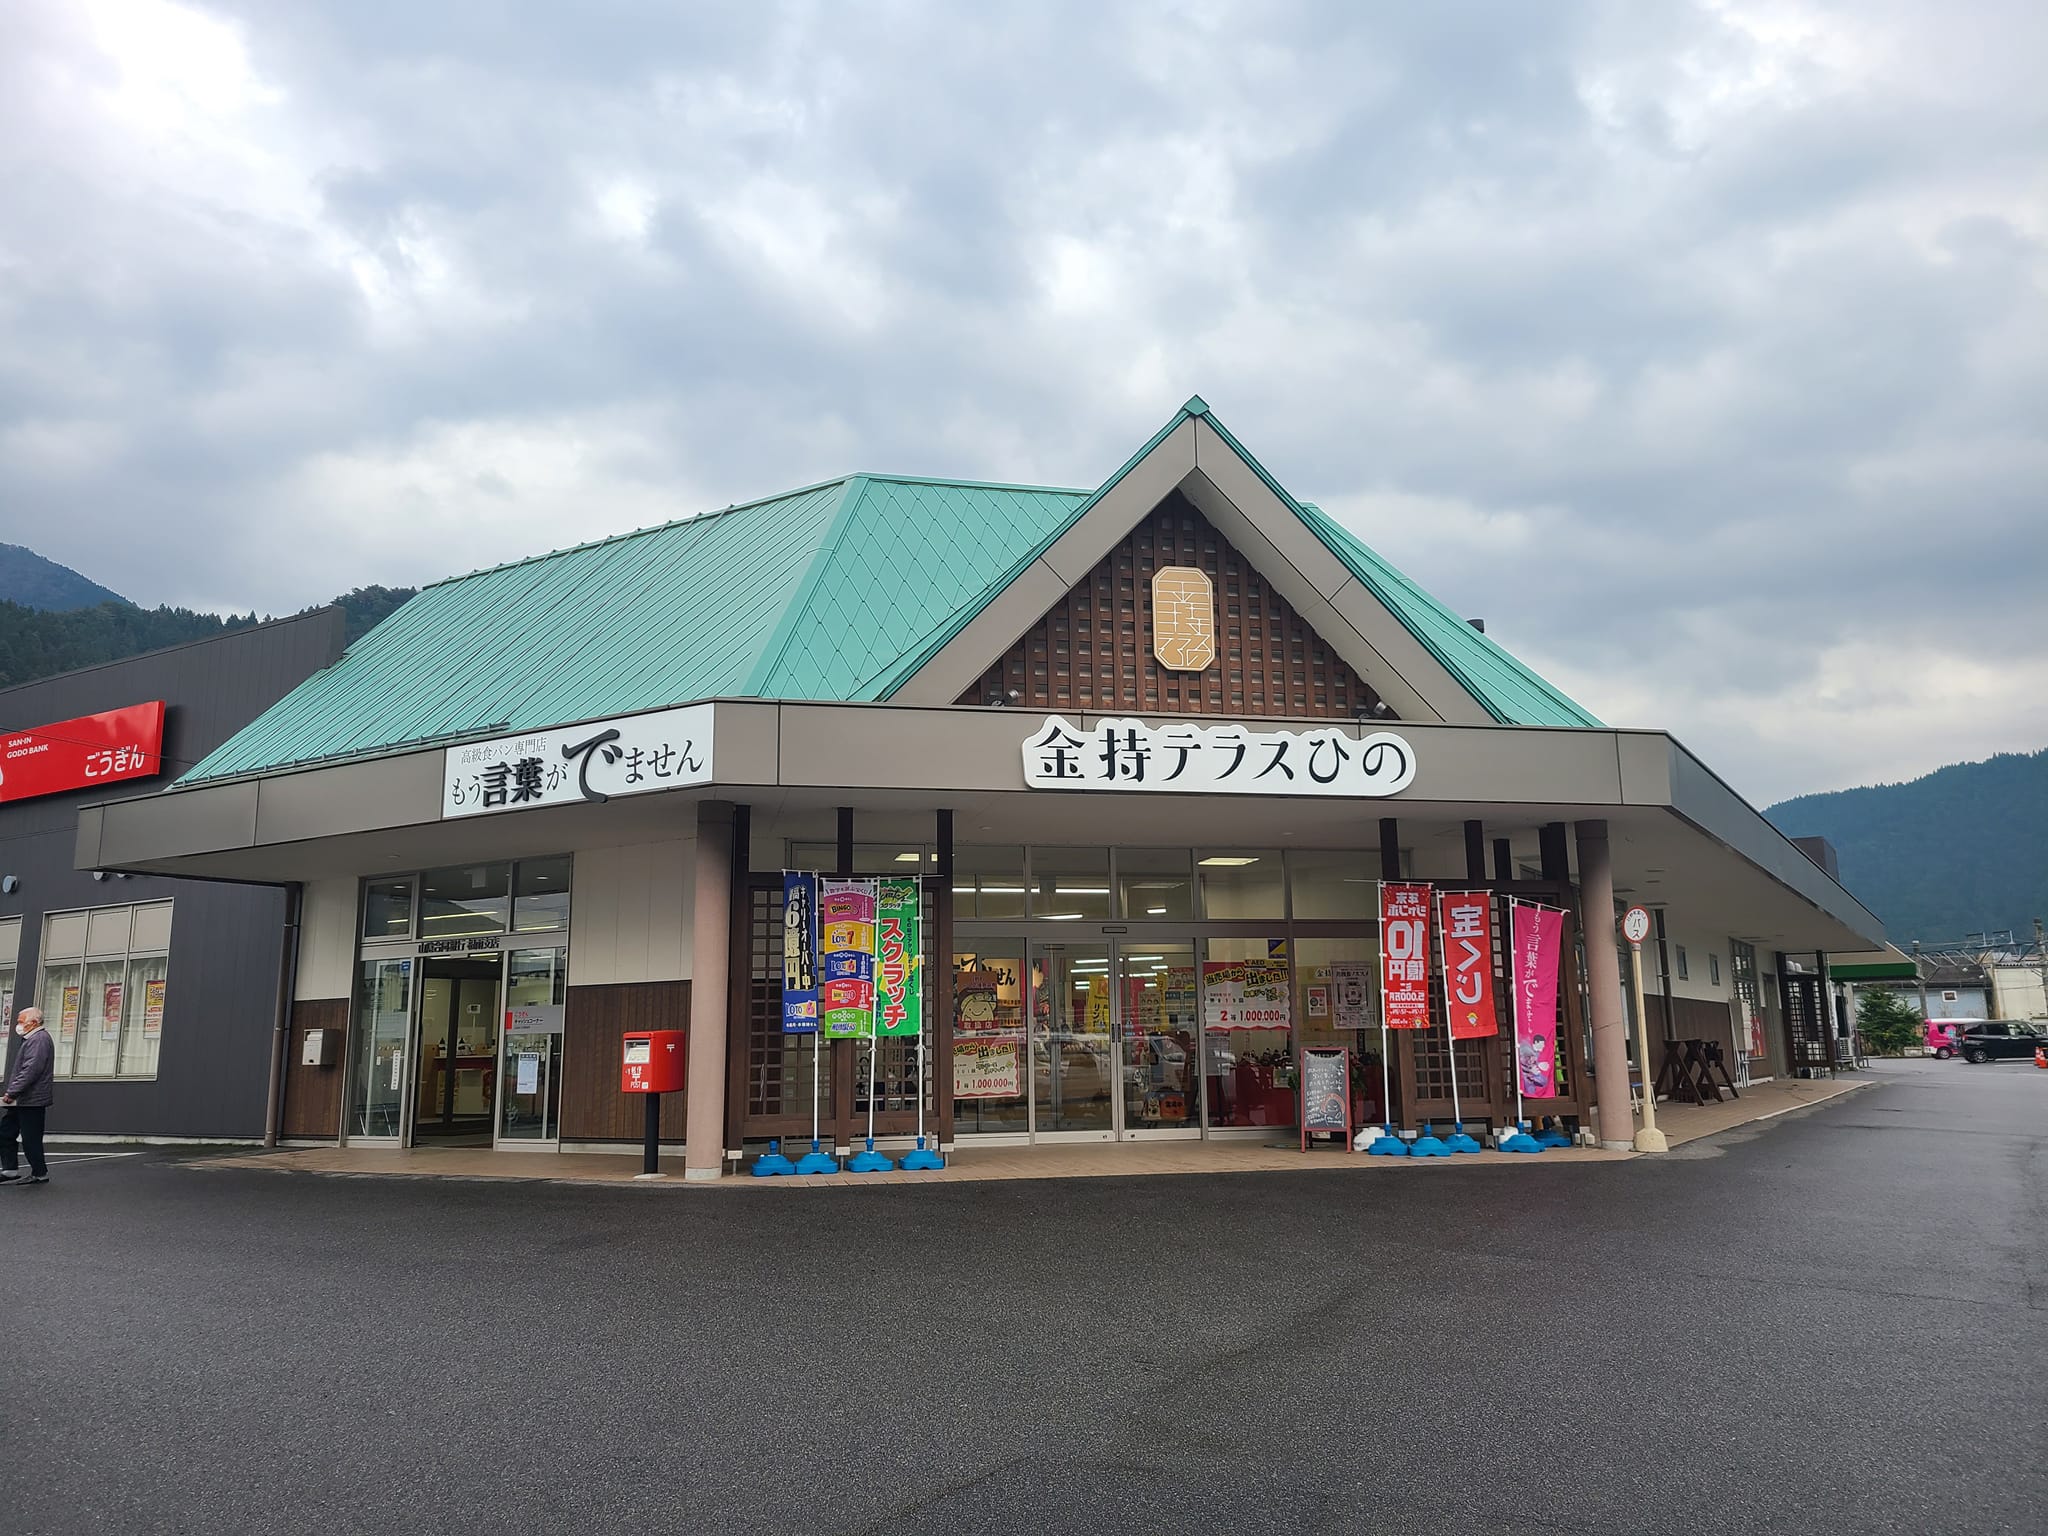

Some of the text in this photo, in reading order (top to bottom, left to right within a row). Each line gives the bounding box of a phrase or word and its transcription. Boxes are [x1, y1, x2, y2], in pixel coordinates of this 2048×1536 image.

[7, 744, 49, 759] GODO BANK
[85, 745, 145, 778] ごうぎん
[460, 737, 547, 765] 高級食パン専門店
[1035, 725, 1407, 784] 金持テラスひの
[451, 728, 704, 804] もう言葉がでません
[1632, 918, 1641, 939] バス
[880, 917, 908, 1030] スクラッチ
[785, 1000, 816, 1016] LOTO 6
[1220, 1010, 1228, 1021] 2
